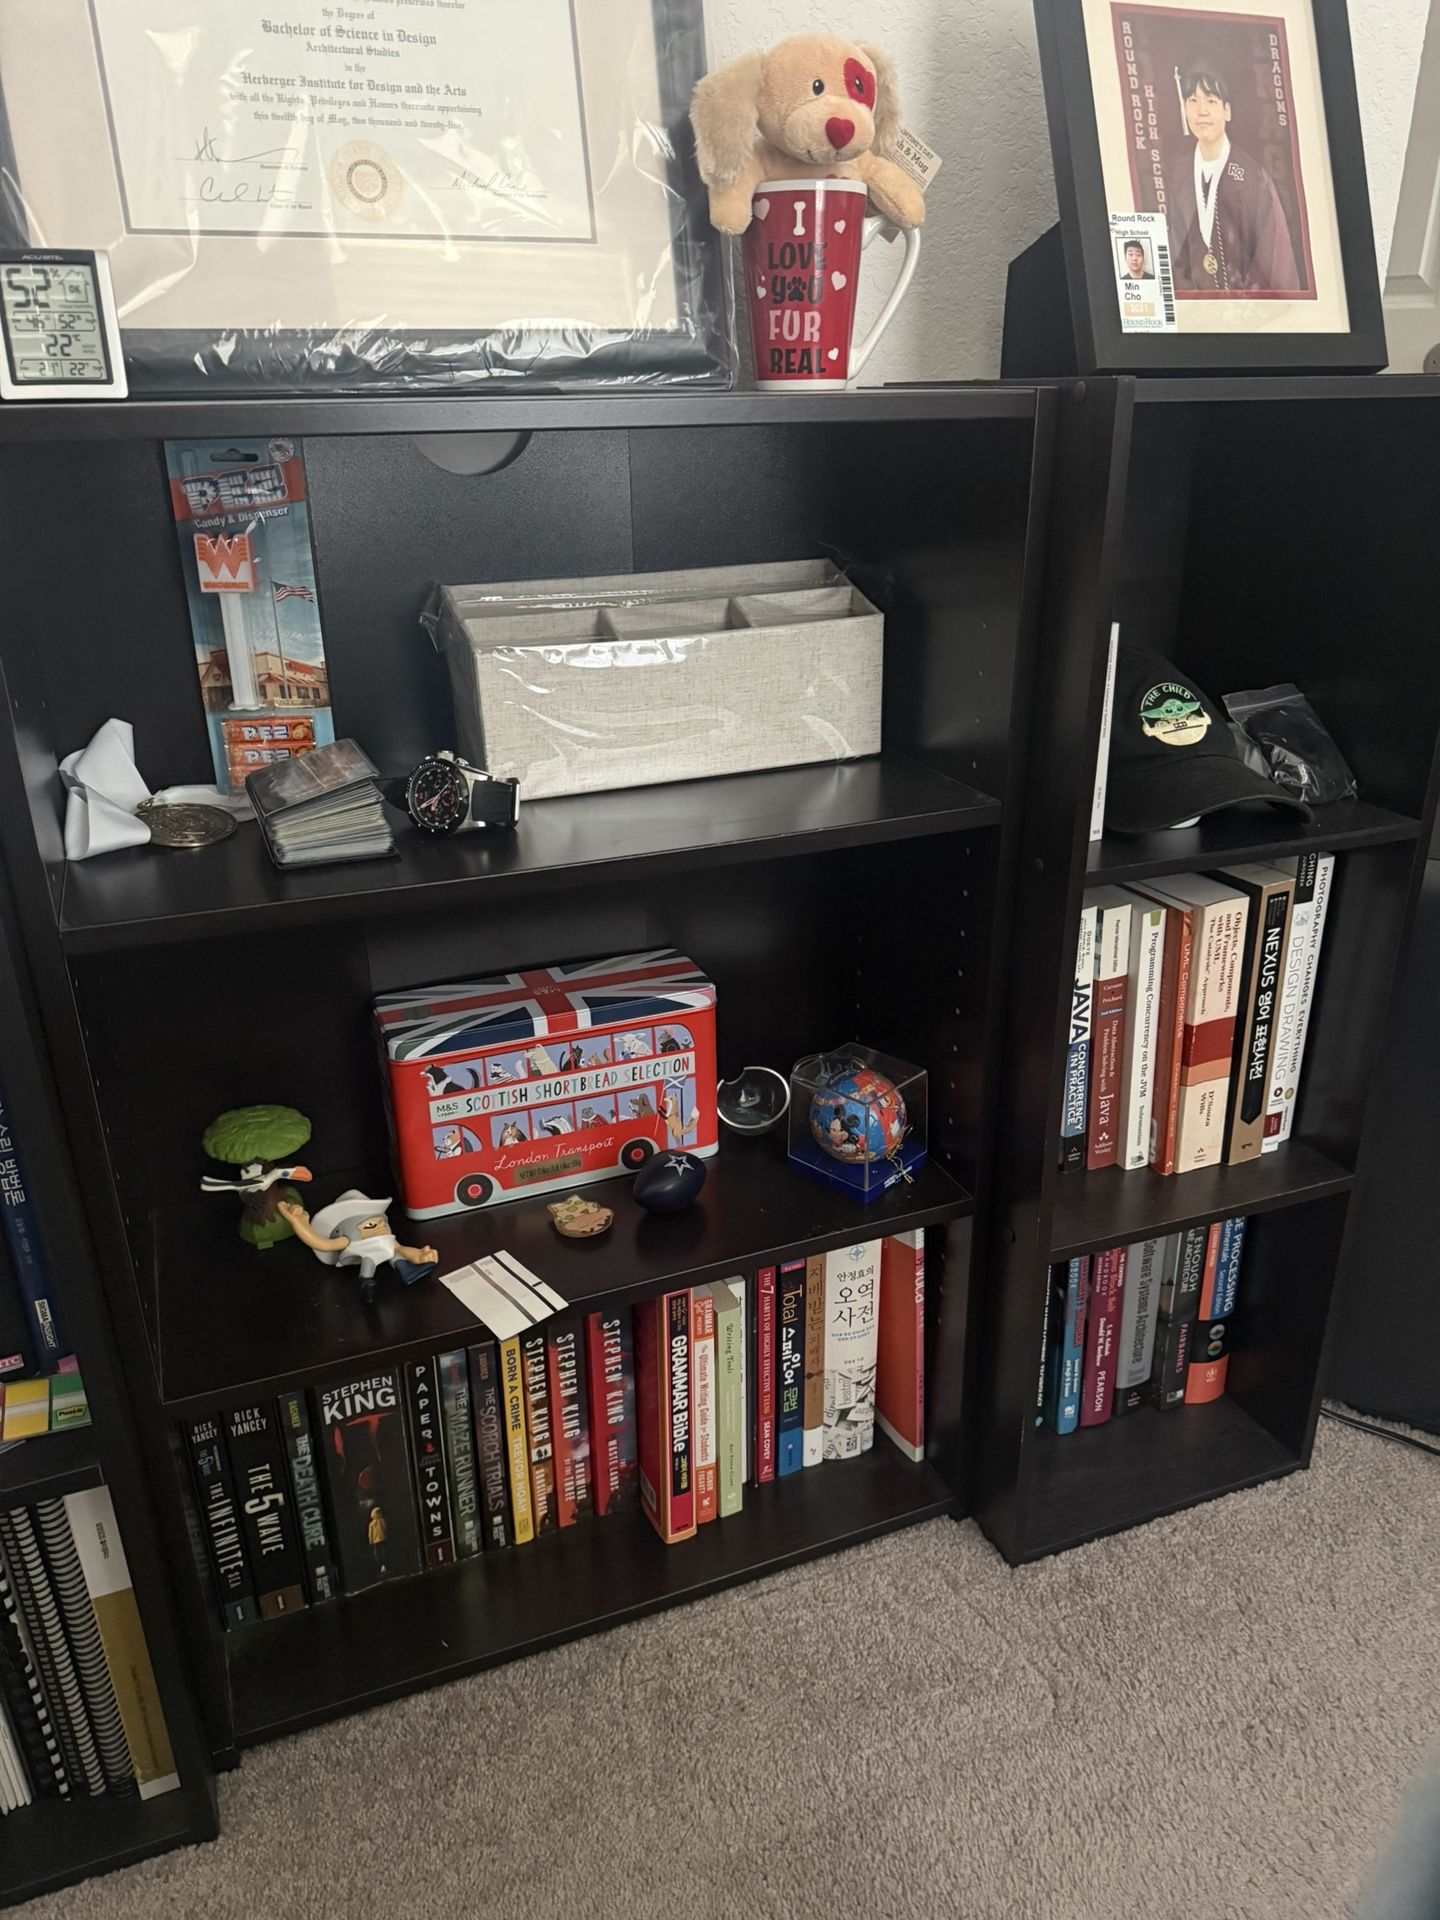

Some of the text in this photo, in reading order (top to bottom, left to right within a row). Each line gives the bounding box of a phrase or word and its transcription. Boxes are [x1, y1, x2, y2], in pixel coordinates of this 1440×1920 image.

[260, 20, 437, 47] Bachelor of Science in Design
[336, 8, 365, 21] Degree
[305, 42, 400, 57] Architectural Studies
[354, 63, 366, 74] the
[241, 72, 467, 97] Herberger Institute for Design and the Arts
[1121, 21, 1147, 150] ROUND ROCK
[1268, 33, 1287, 126] DRAGONS
[911, 152, 929, 173] Mug
[1143, 84, 1167, 214] HIGH SCHOO
[1112, 214, 1135, 222] Round
[767, 241, 828, 270] LOVE
[69, 285, 81, 294] OK
[1124, 282, 1140, 291] Min
[1124, 292, 1141, 300] Cho
[768, 309, 821, 343] FUR
[769, 348, 827, 375] REAL
[180, 463, 288, 514] PEZ
[194, 506, 289, 528] Candy Dispenser
[1144, 684, 1191, 706] THE CHILD
[241, 724, 288, 741] PEZ
[1304, 852, 1316, 887] CHING
[1213, 915, 1225, 965] with UML
[1218, 913, 1233, 992] and Frameworks
[1224, 911, 1243, 1013] Objects, Components,
[1260, 927, 1281, 987] NEXUS
[1289, 865, 1329, 1074] PHOTOGRAPHY CHANGES EVERYTHING
[1069, 978, 1091, 1044] JAVA
[1139, 931, 1158, 1099] Programming Concurrency JVM
[1177, 972, 1188, 1038] Components
[1200, 976, 1210, 1016] Approach
[1274, 935, 1305, 1080] DESIGN DRAWING
[1249, 990, 1273, 1080] 영어 표현사전
[466, 1056, 690, 1113] SCOTTISH SHORTBREAD SELECTION
[1067, 1054, 1078, 1125] IN PRACTICE
[1073, 1043, 1087, 1131] CONCURRENCY
[1199, 1091, 1208, 1115] Wills
[436, 1102, 459, 1114] M&S
[1099, 1094, 1114, 1125] Java
[1205, 1090, 1215, 1127] D'Souza
[494, 1151, 550, 1172] London
[552, 1136, 615, 1158] Transport
[836, 1265, 875, 1283] 안정효의
[1179, 1243, 1193, 1294] ARCHITECTURE
[1188, 1235, 1203, 1292] ENOUGH
[1223, 1233, 1242, 1312] PROCESSING
[37, 1301, 51, 1323] SIGMA
[782, 1284, 802, 1325] Total
[832, 1279, 875, 1306] 오역
[1131, 1239, 1157, 1365] Software Systems Architecture
[703, 1299, 713, 1335] GRAMMAR
[831, 1306, 875, 1329] 사전
[725, 1323, 735, 1374] Writing Tools
[760, 1285, 773, 1414] 7 HABITS HIGHLY EFFECTIVE TEENS
[781, 1326, 801, 1385] 스페인어
[1175, 1323, 1188, 1374] FAIRBANKS
[322, 1375, 394, 1405] STEPHEN
[505, 1348, 521, 1432] BORN A CRIME
[525, 1337, 551, 1444] STEPHEN KING
[556, 1332, 581, 1440] STEPHEN KING
[603, 1319, 624, 1426] STEPHEN KING
[671, 1335, 688, 1412] GRAMMAR
[1094, 1370, 1106, 1412] PEARSON
[234, 1407, 261, 1422] RICK
[323, 1387, 397, 1425] KING
[698, 1354, 710, 1462] Ultimate Writing Guide Students
[783, 1387, 799, 1413] 문법
[192, 1427, 218, 1445] YANCEY
[193, 1421, 213, 1435] RICK
[231, 1418, 268, 1438] YANCEY
[333, 1411, 397, 1462] IT
[450, 1407, 472, 1456] MAZE
[672, 1413, 688, 1454] Bible
[763, 1421, 771, 1459] SEAN COVEY
[415, 1365, 434, 1440] PAPER
[426, 1466, 442, 1537] TOWNS
[480, 1406, 504, 1512] SCORCH TRIALS
[608, 1439, 619, 1491] WASTE LANDS
[454, 1456, 475, 1517] RUNNER
[511, 1435, 527, 1514] TREVOR NOAH
[698, 1471, 706, 1495] FOGARTY
[705, 1470, 713, 1490] MIGNON
[244, 1463, 284, 1556] THE 5 WAVE
[292, 1456, 326, 1551] DEATH CURE
[208, 1482, 244, 1589] THE INFINITE SEA
